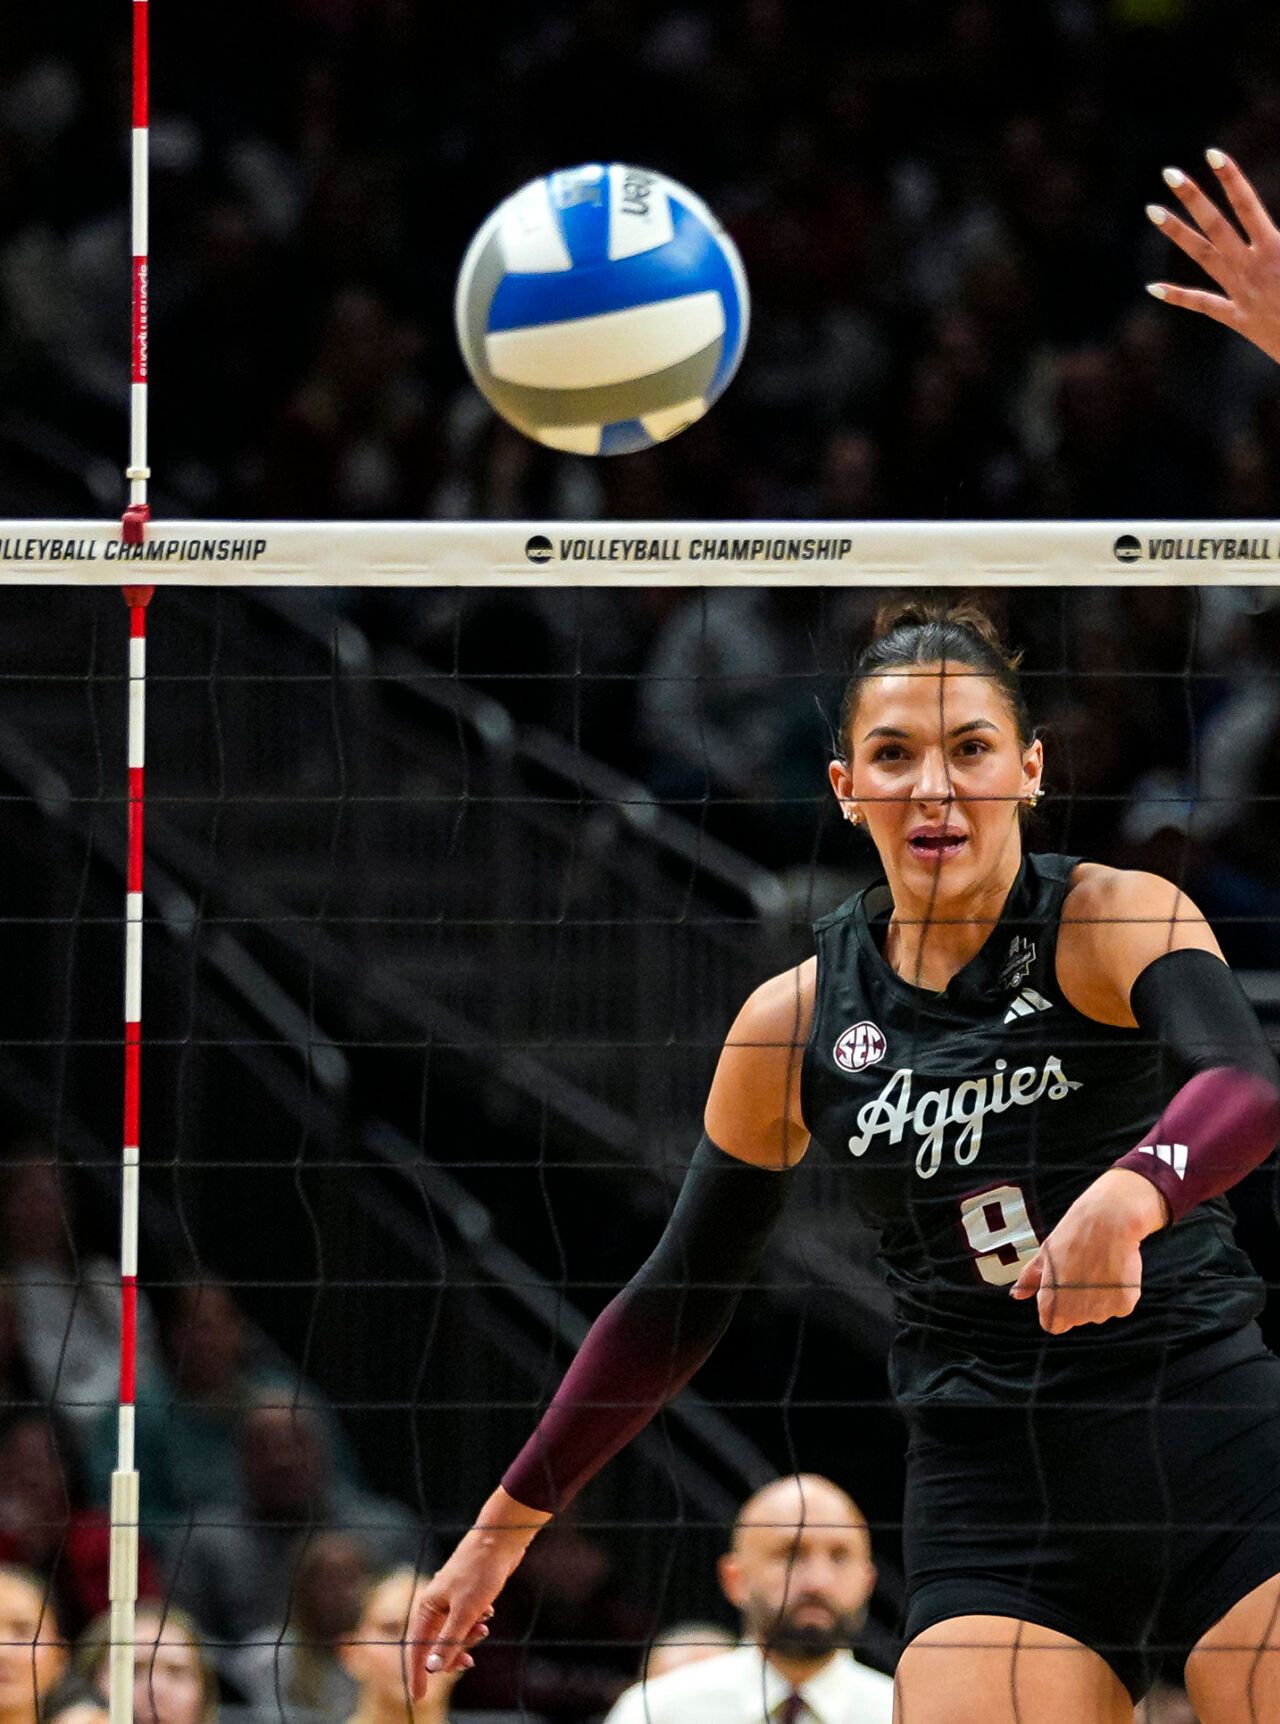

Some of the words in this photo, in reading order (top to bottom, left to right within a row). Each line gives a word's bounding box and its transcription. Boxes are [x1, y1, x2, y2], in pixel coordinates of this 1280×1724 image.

[0, 538, 97, 561] LLEYBALL
[103, 538, 267, 561] CHAMPIONSHIP
[559, 538, 682, 561] VOLLEYBALL
[688, 538, 852, 561] CHAMPIONSHIP
[1148, 538, 1271, 560] VOLLEYBALL
[836, 1023, 885, 1069] SEC
[848, 1055, 1084, 1179] Aggies
[960, 1184, 1042, 1287] 9
